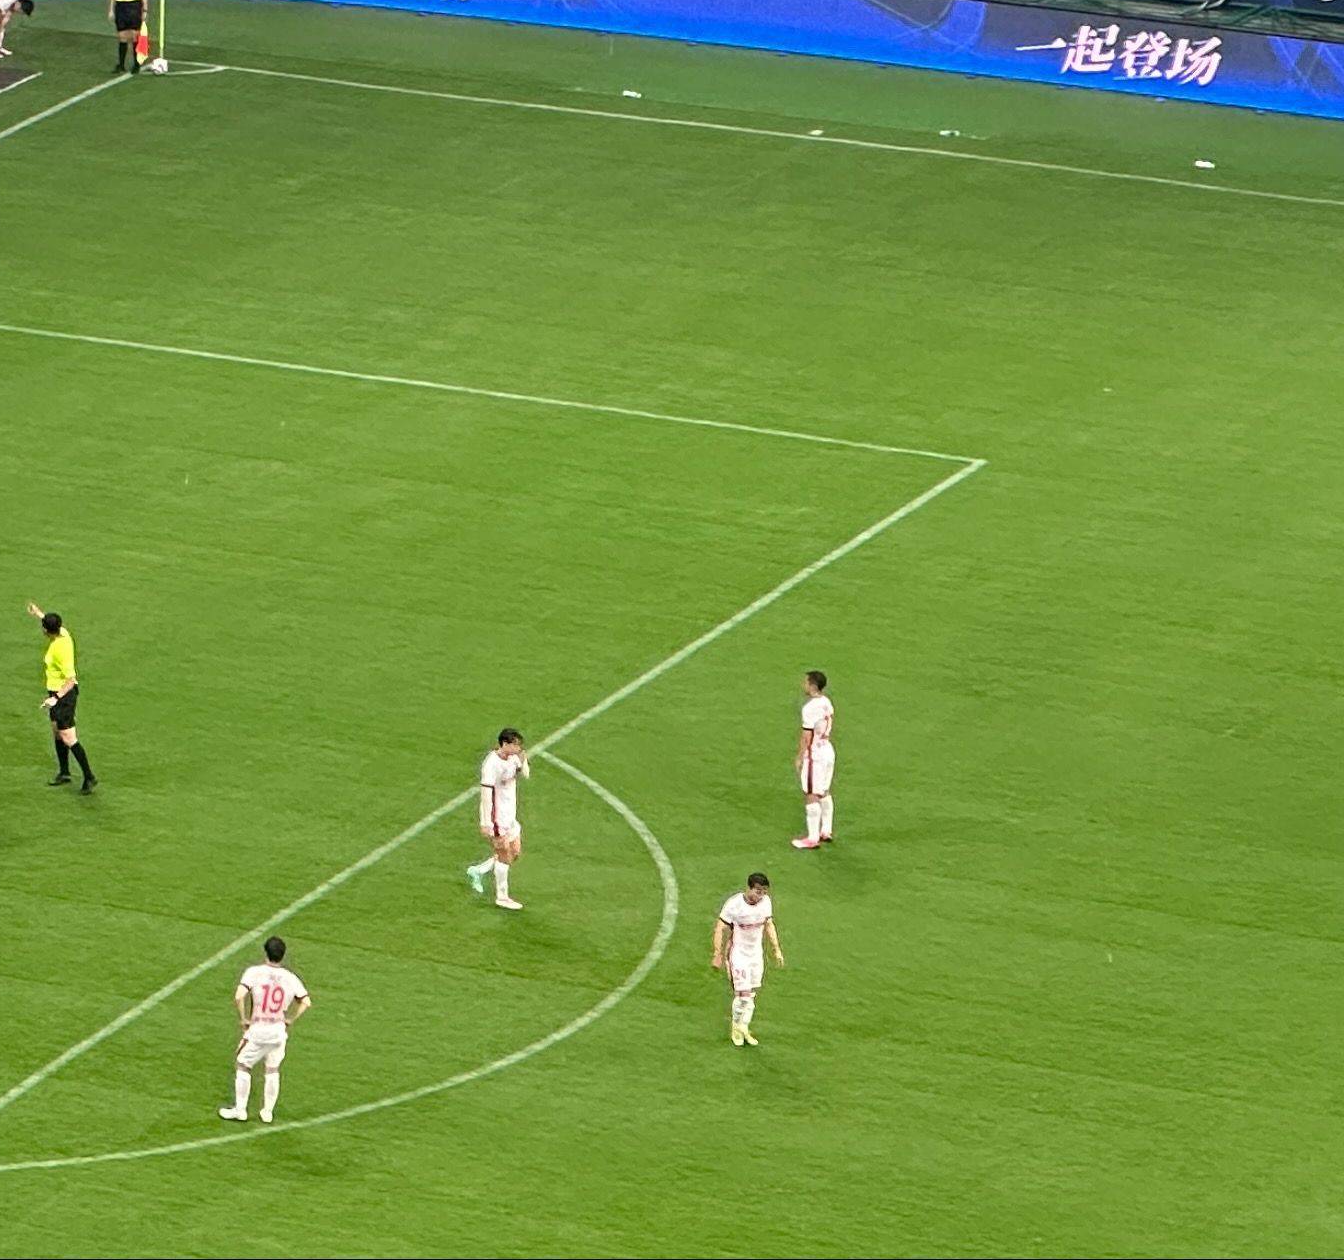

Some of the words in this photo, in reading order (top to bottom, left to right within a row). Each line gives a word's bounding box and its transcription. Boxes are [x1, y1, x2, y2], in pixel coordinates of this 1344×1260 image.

[1015, 24, 1222, 86] 一起登场
[260, 983, 285, 1013] 19
